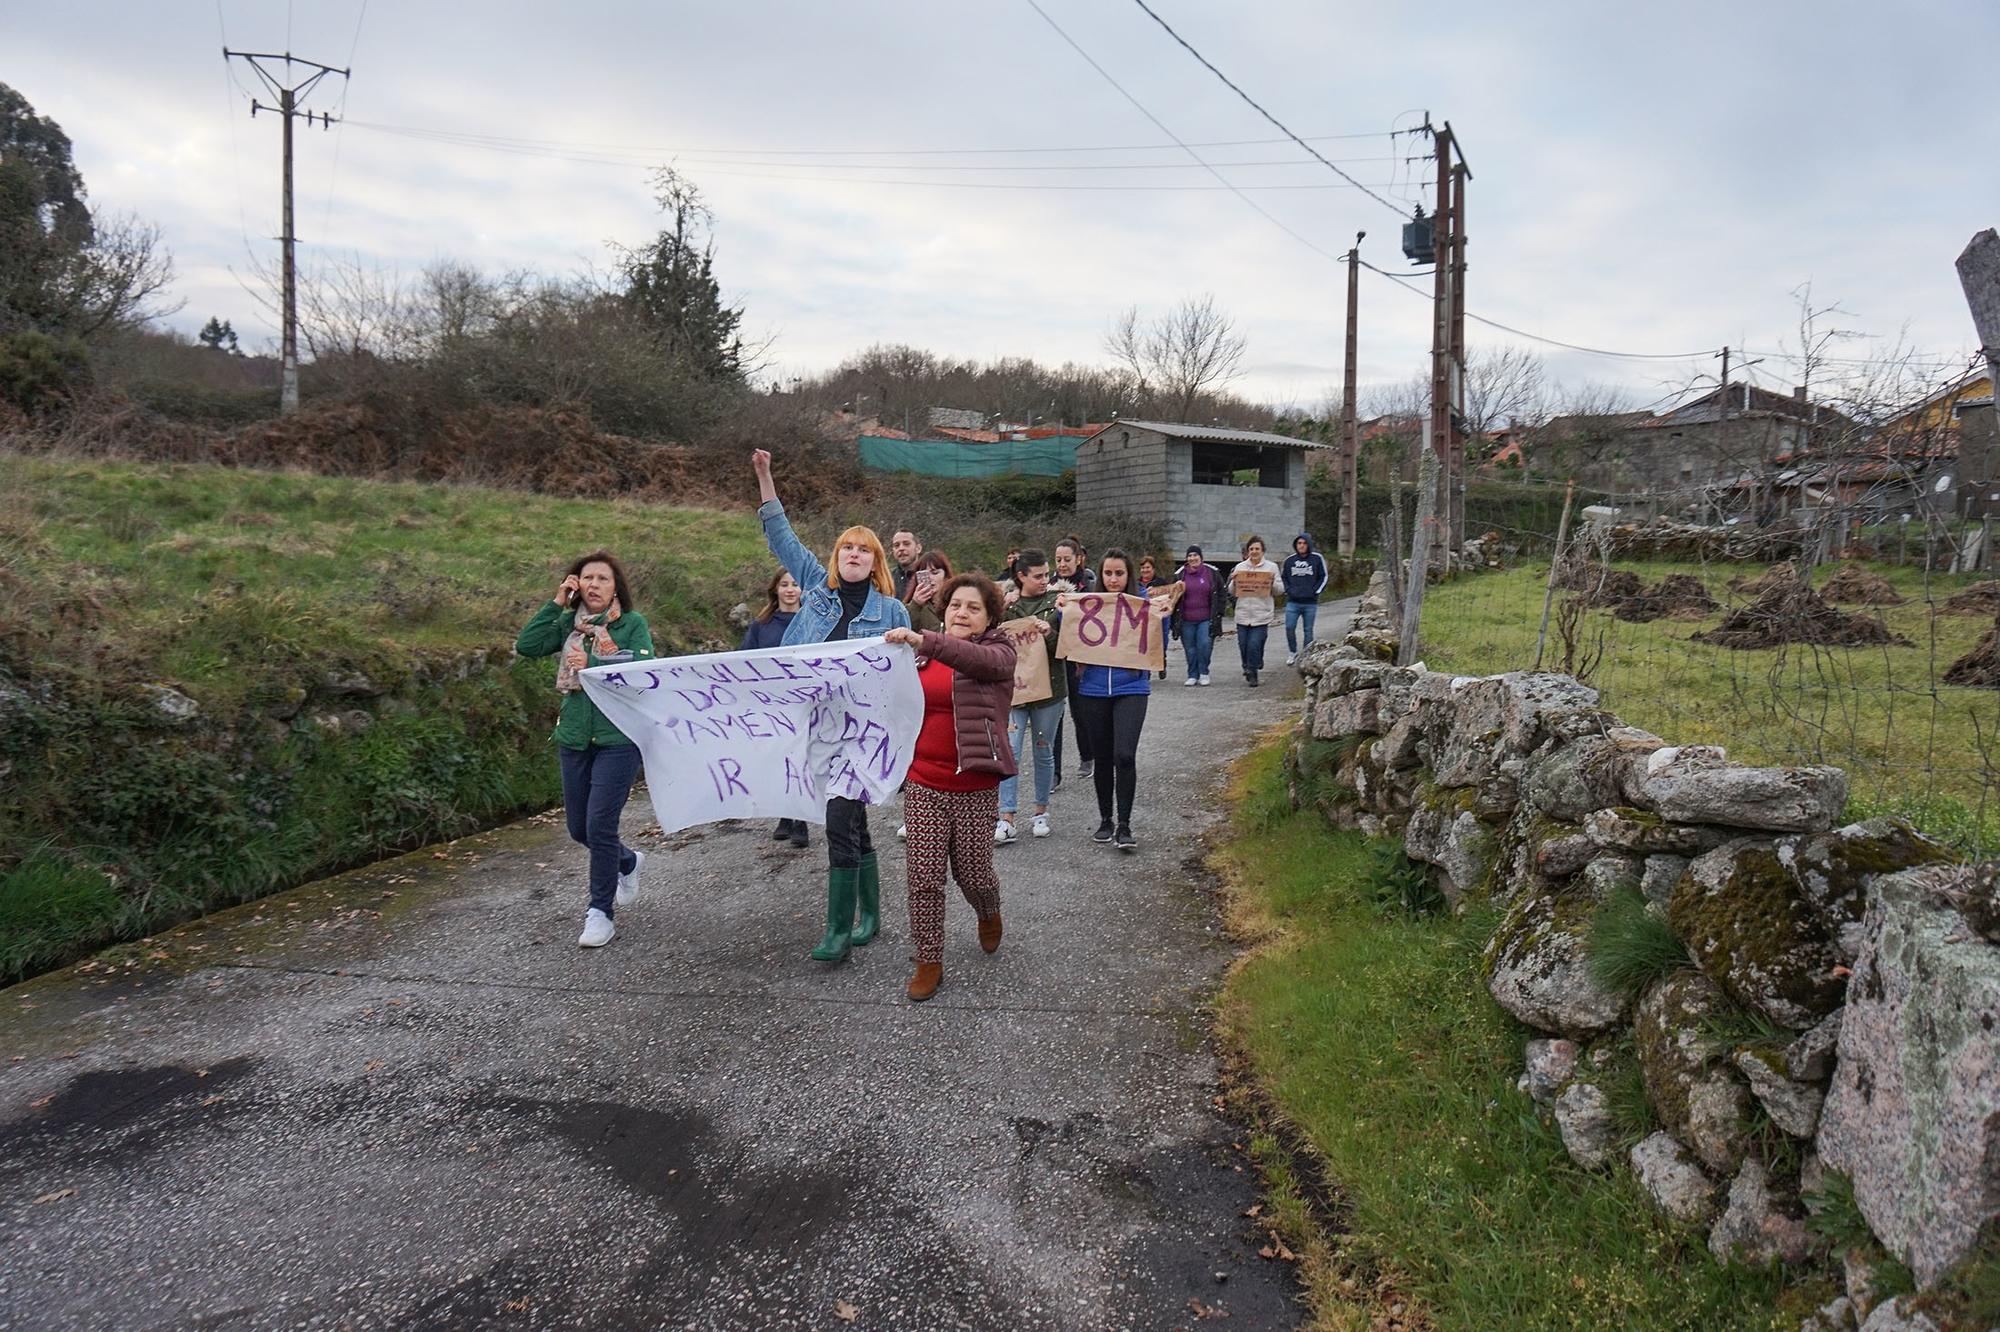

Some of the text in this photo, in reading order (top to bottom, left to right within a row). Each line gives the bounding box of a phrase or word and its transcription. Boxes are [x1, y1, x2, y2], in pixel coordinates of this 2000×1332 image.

[1079, 594, 1150, 655] 8M
[673, 684, 738, 711] DO
[707, 757, 750, 802] IR
